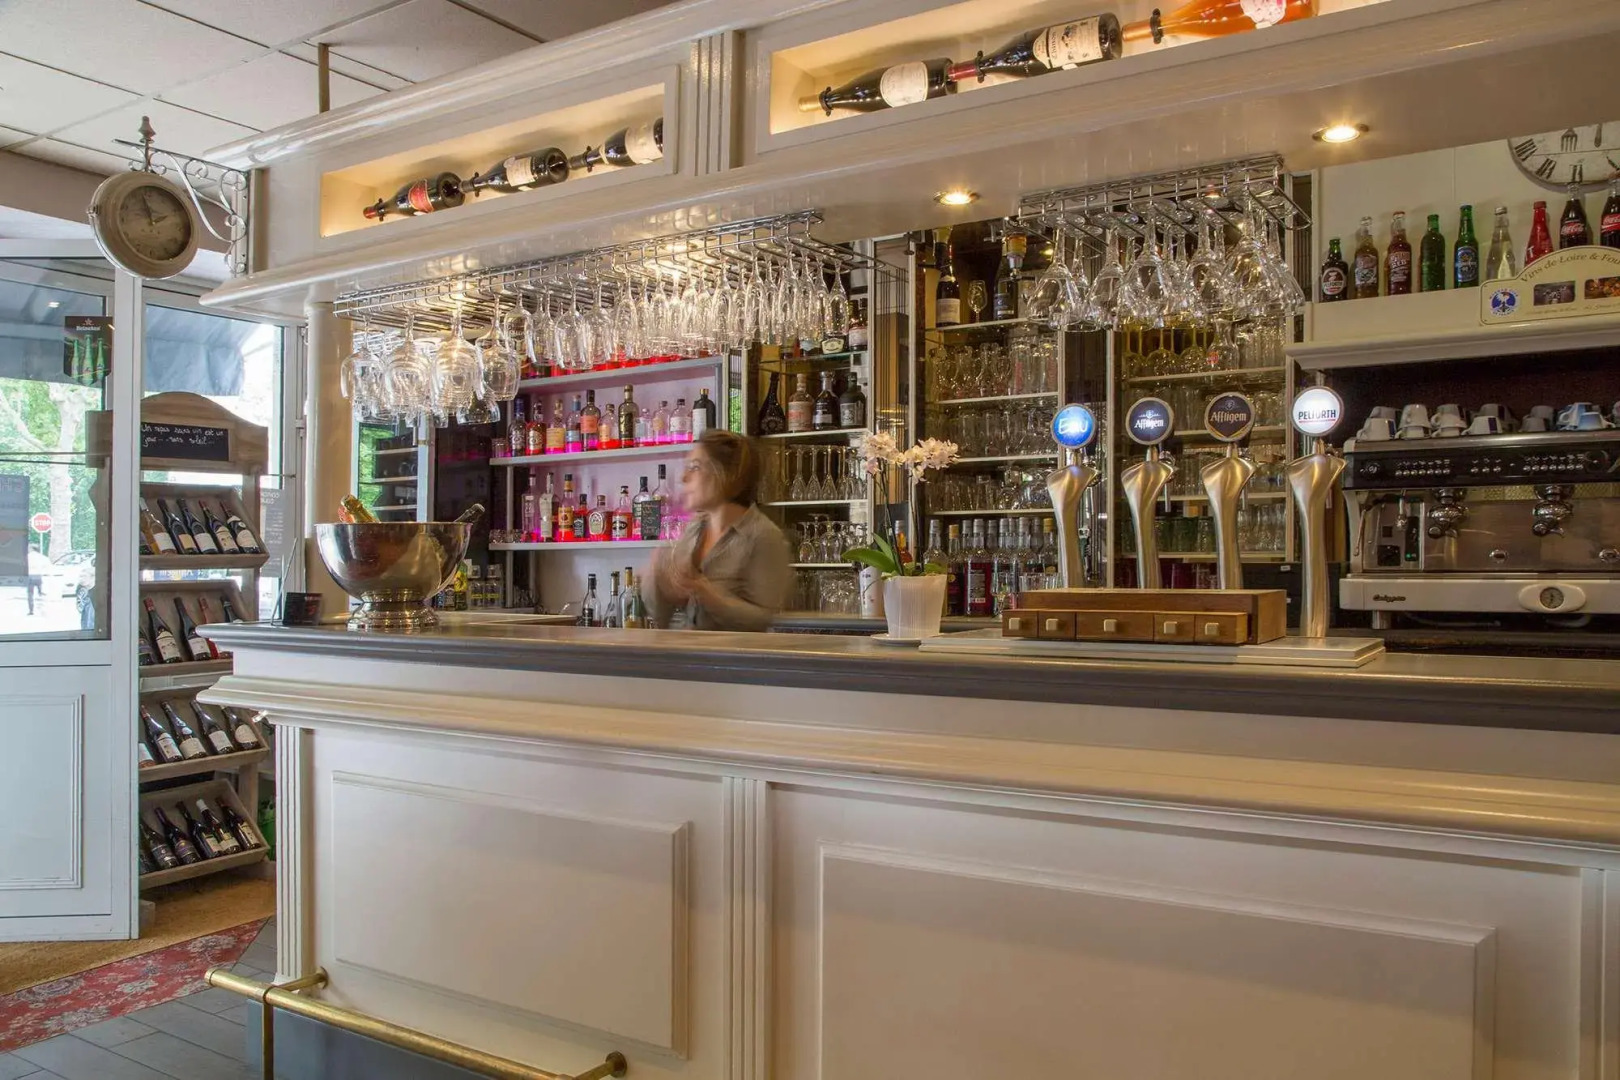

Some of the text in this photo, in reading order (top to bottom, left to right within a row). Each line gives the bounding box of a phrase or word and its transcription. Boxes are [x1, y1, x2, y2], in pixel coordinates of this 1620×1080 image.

[1521, 266, 1544, 282] Vins
[1544, 259, 1557, 268] de
[1559, 253, 1588, 264] Loire
[1210, 411, 1247, 424] Affligem
